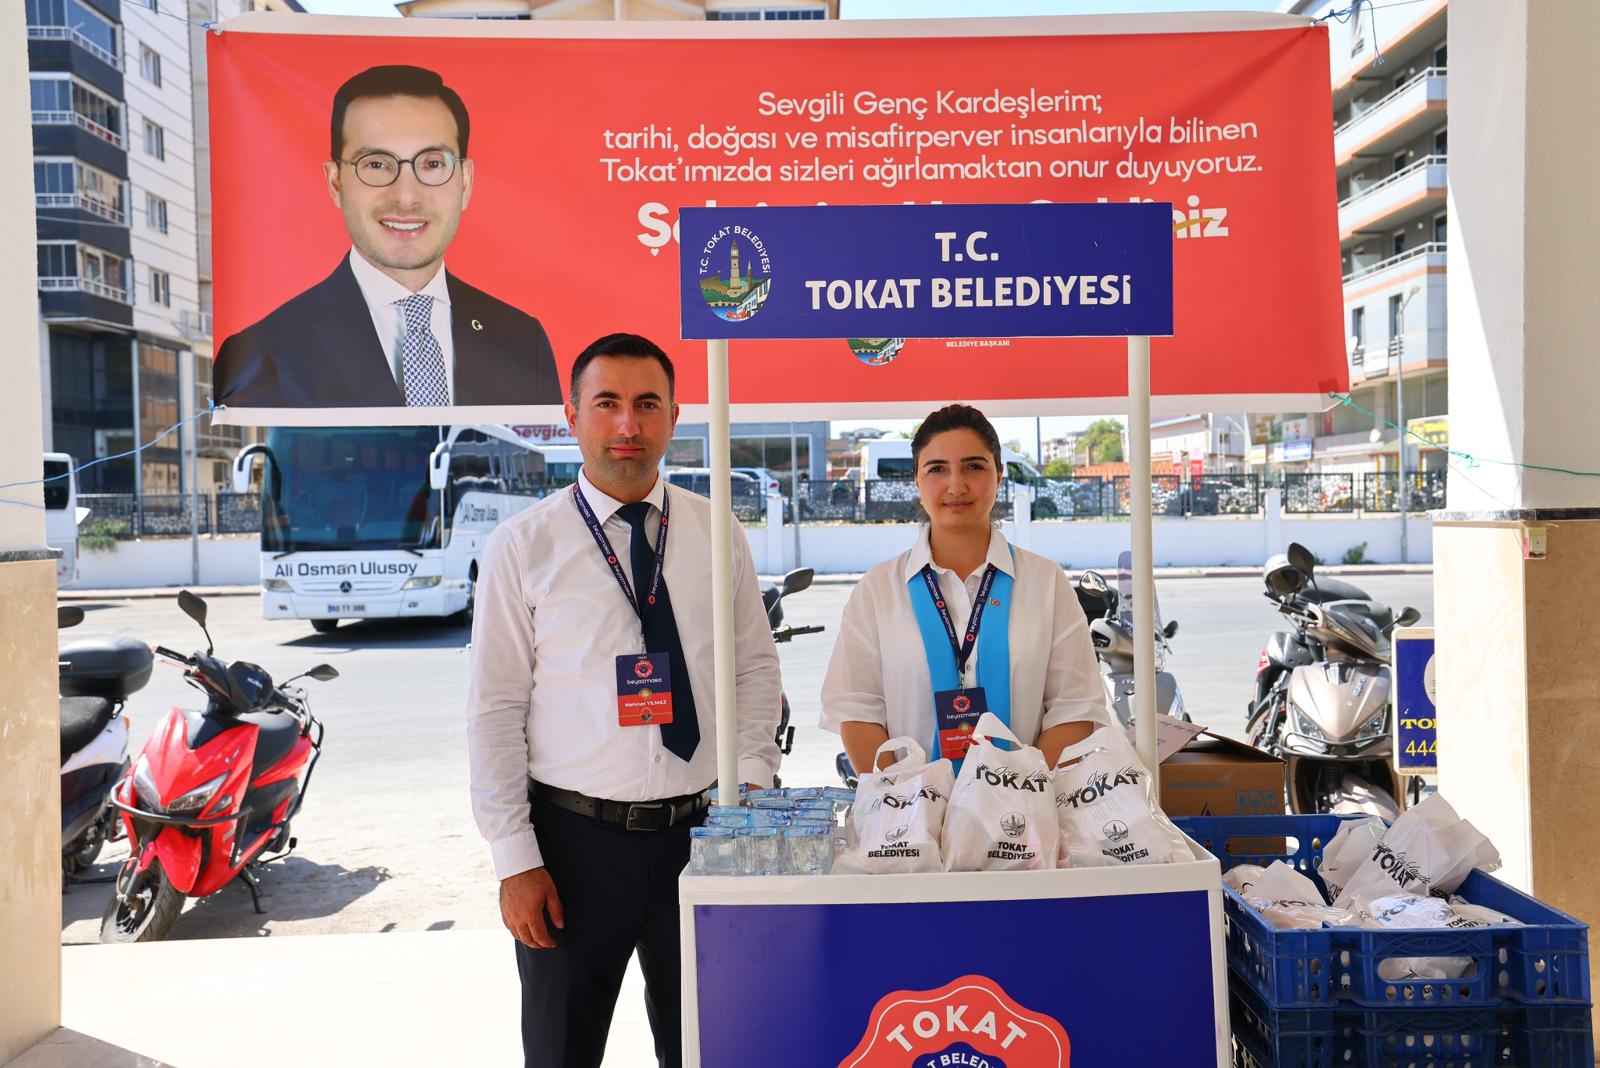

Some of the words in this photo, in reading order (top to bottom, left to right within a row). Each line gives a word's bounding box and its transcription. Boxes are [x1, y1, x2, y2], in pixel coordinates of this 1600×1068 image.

[758, 91, 844, 122] Sevgili
[853, 91, 928, 120] Genç
[936, 88, 1102, 118] Kardeşlerim;
[603, 124, 679, 152] tarihi,
[688, 124, 776, 156] doğası
[785, 132, 818, 149] ve
[826, 123, 1002, 155] misafirperver
[1011, 117, 1162, 150] insanlarıyla
[1169, 116, 1257, 143] bilinen
[780, 156, 854, 181] sizleri
[863, 154, 1042, 188] ağırlamaktan
[1050, 158, 1109, 178] onur
[1116, 151, 1263, 185] duyuyoruz.
[703, 226, 731, 254] TOKAT
[934, 231, 999, 262] T.C.
[805, 278, 921, 310] TOKAT
[931, 275, 1131, 308] BELEDİYESİ
[275, 564, 293, 577] Ali
[297, 562, 357, 577] Osman
[360, 561, 418, 577] Ulusoy
[976, 765, 1048, 793] TOKAT
[1067, 771, 1140, 809] TOKAT
[881, 786, 943, 810] OKAT
[998, 841, 1028, 852] TOKAT
[1372, 843, 1416, 889] TOKAT
[885, 1004, 1028, 1053] TOKAT
